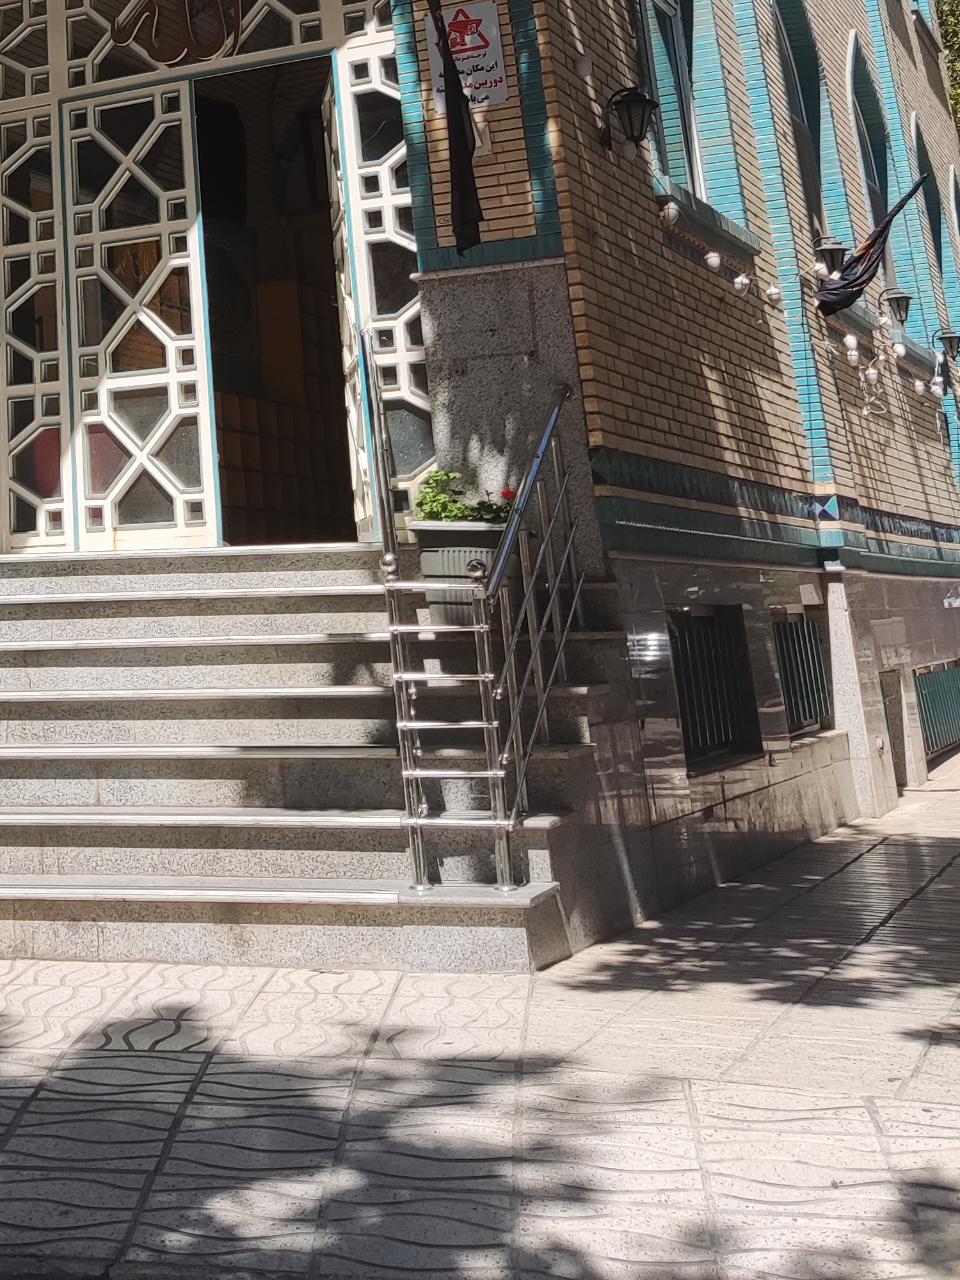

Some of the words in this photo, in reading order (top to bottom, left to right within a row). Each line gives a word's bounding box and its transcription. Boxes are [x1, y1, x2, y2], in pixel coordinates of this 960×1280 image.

[466, 64, 485, 76] مکان
[486, 60, 498, 72] این
[474, 76, 503, 90] دوربین
